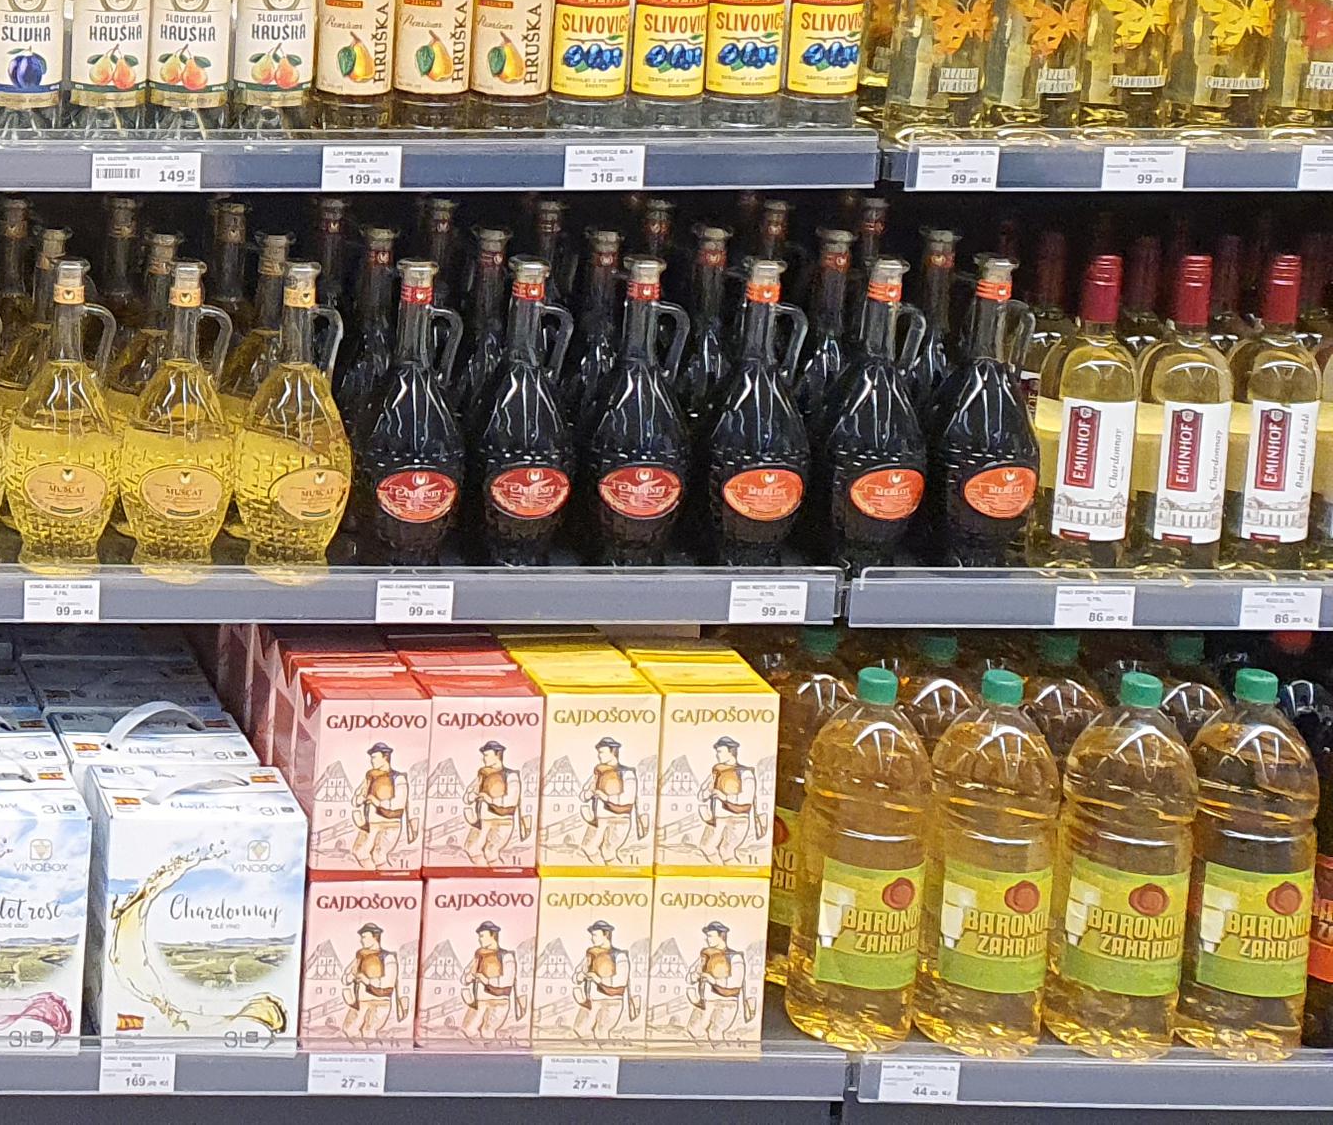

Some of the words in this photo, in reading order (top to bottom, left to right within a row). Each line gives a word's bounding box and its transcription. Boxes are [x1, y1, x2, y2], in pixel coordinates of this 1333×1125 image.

[1073, 420, 1091, 480] EMINHOF
[1108, 427, 1123, 490] Chardonnay
[1175, 421, 1193, 483] EMINHOF
[1208, 429, 1223, 491] Chardonnay
[1264, 421, 1283, 485] EMINHOF
[326, 710, 427, 730] GAJDOŠOVO
[437, 708, 539, 727] GAJDOŠOVO
[554, 706, 656, 725] GAJDOŠOVO
[671, 706, 775, 725] GAJDOŠOVO
[14, 862, 69, 873] VINOBOX
[316, 891, 417, 911] GAJDOŠOVO
[435, 891, 533, 910] GAJDOŠOVO
[547, 890, 649, 908] GAJDOŠOVO
[660, 889, 765, 908] GAJDOŠOVO
[169, 894, 283, 927] Chardonnay
